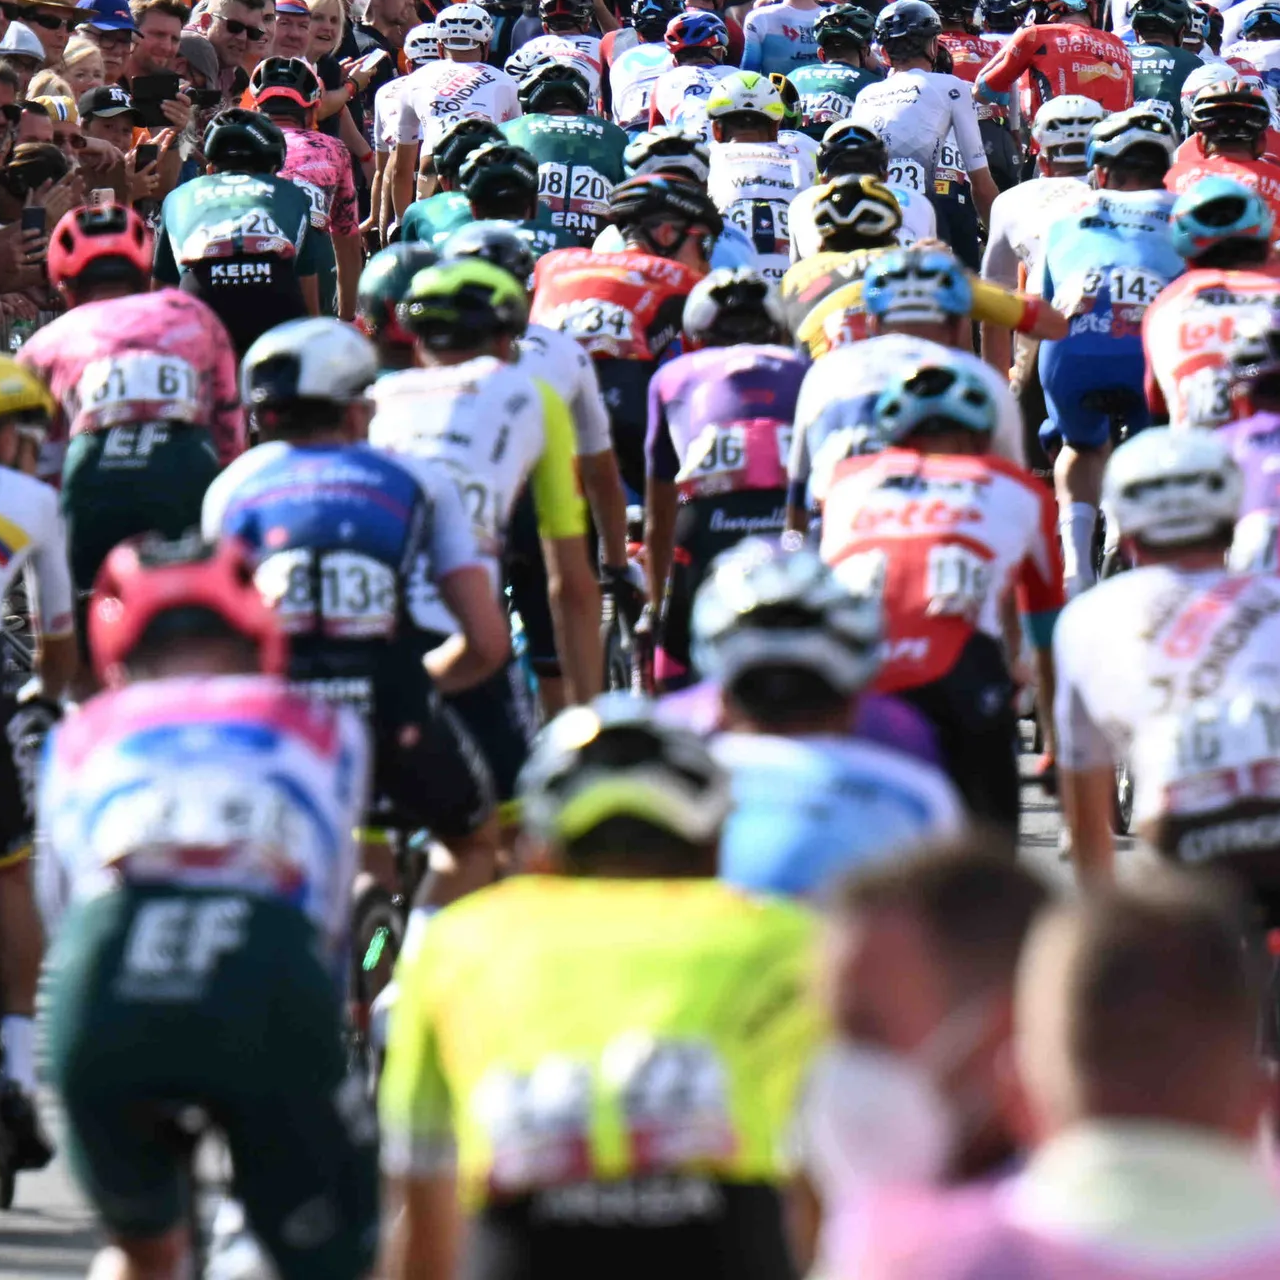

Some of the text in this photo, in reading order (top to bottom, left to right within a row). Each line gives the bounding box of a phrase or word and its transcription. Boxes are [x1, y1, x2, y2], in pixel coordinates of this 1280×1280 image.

[1055, 35, 1132, 60] BAHRAIN
[1071, 61, 1109, 75] Bapco
[1130, 59, 1176, 70] ERN
[731, 174, 795, 191] Wallonie
[211, 263, 271, 278] KERN
[585, 306, 627, 335] 34
[123, 896, 254, 972] EF
